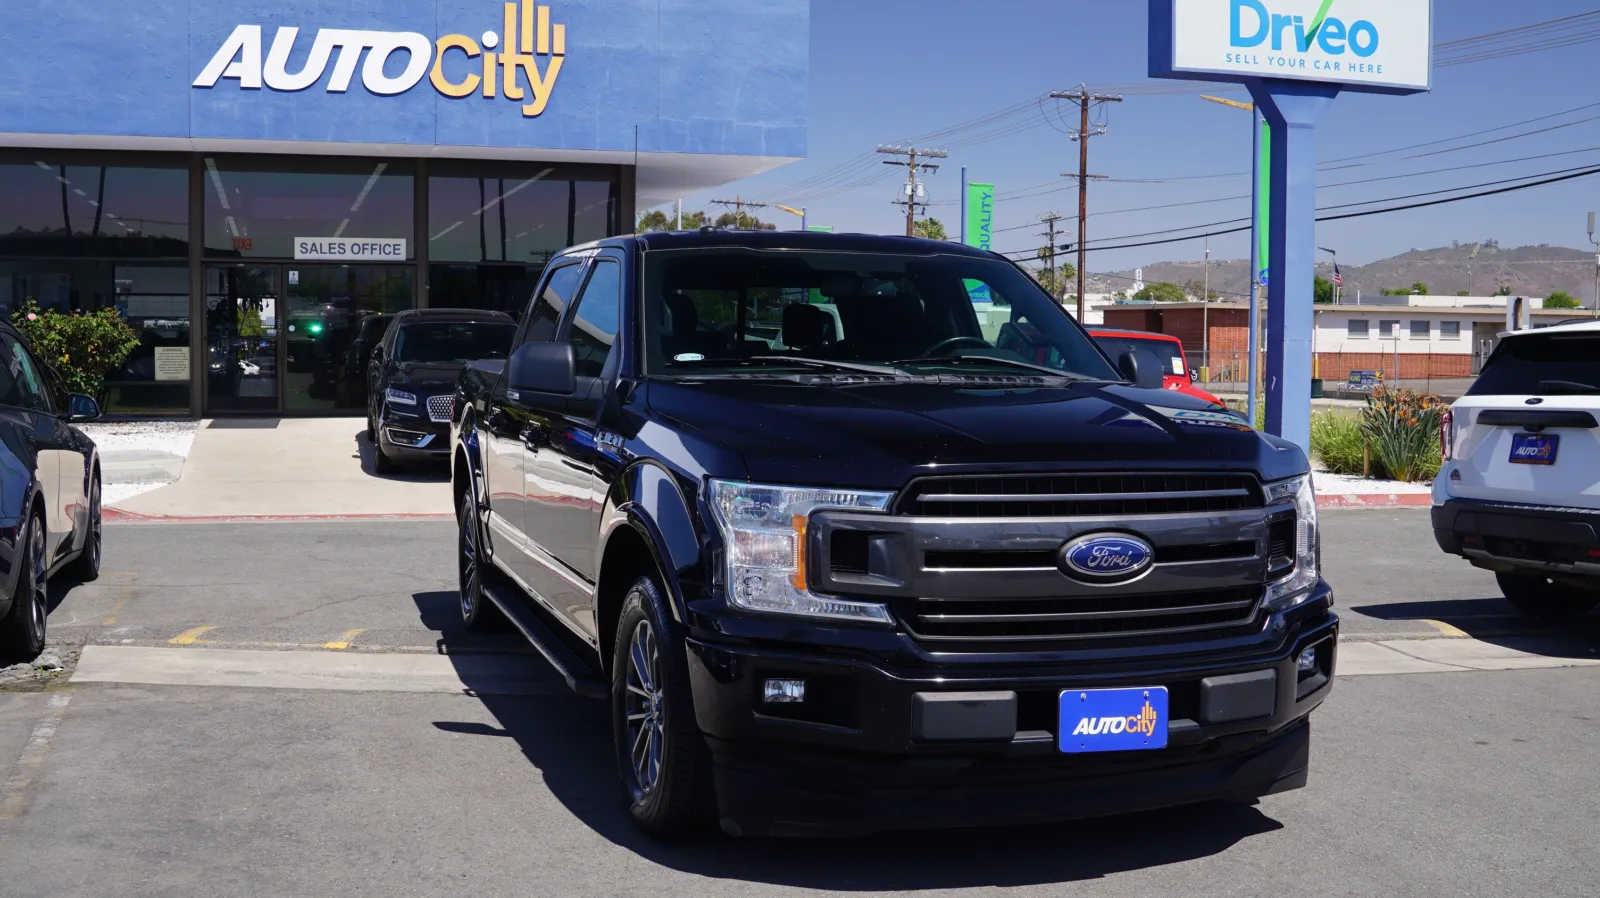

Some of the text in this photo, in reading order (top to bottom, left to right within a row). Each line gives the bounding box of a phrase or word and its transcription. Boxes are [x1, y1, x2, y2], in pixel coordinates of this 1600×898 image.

[1229, 0, 1379, 57] Driveo
[192, 1, 566, 117] AUTOCity
[1225, 53, 1383, 74] SELL YOUR CAR HERE
[299, 242, 402, 256] SALES OFFICE
[1087, 546, 1133, 567] Ford
[1072, 701, 1156, 736] AUTOCity
